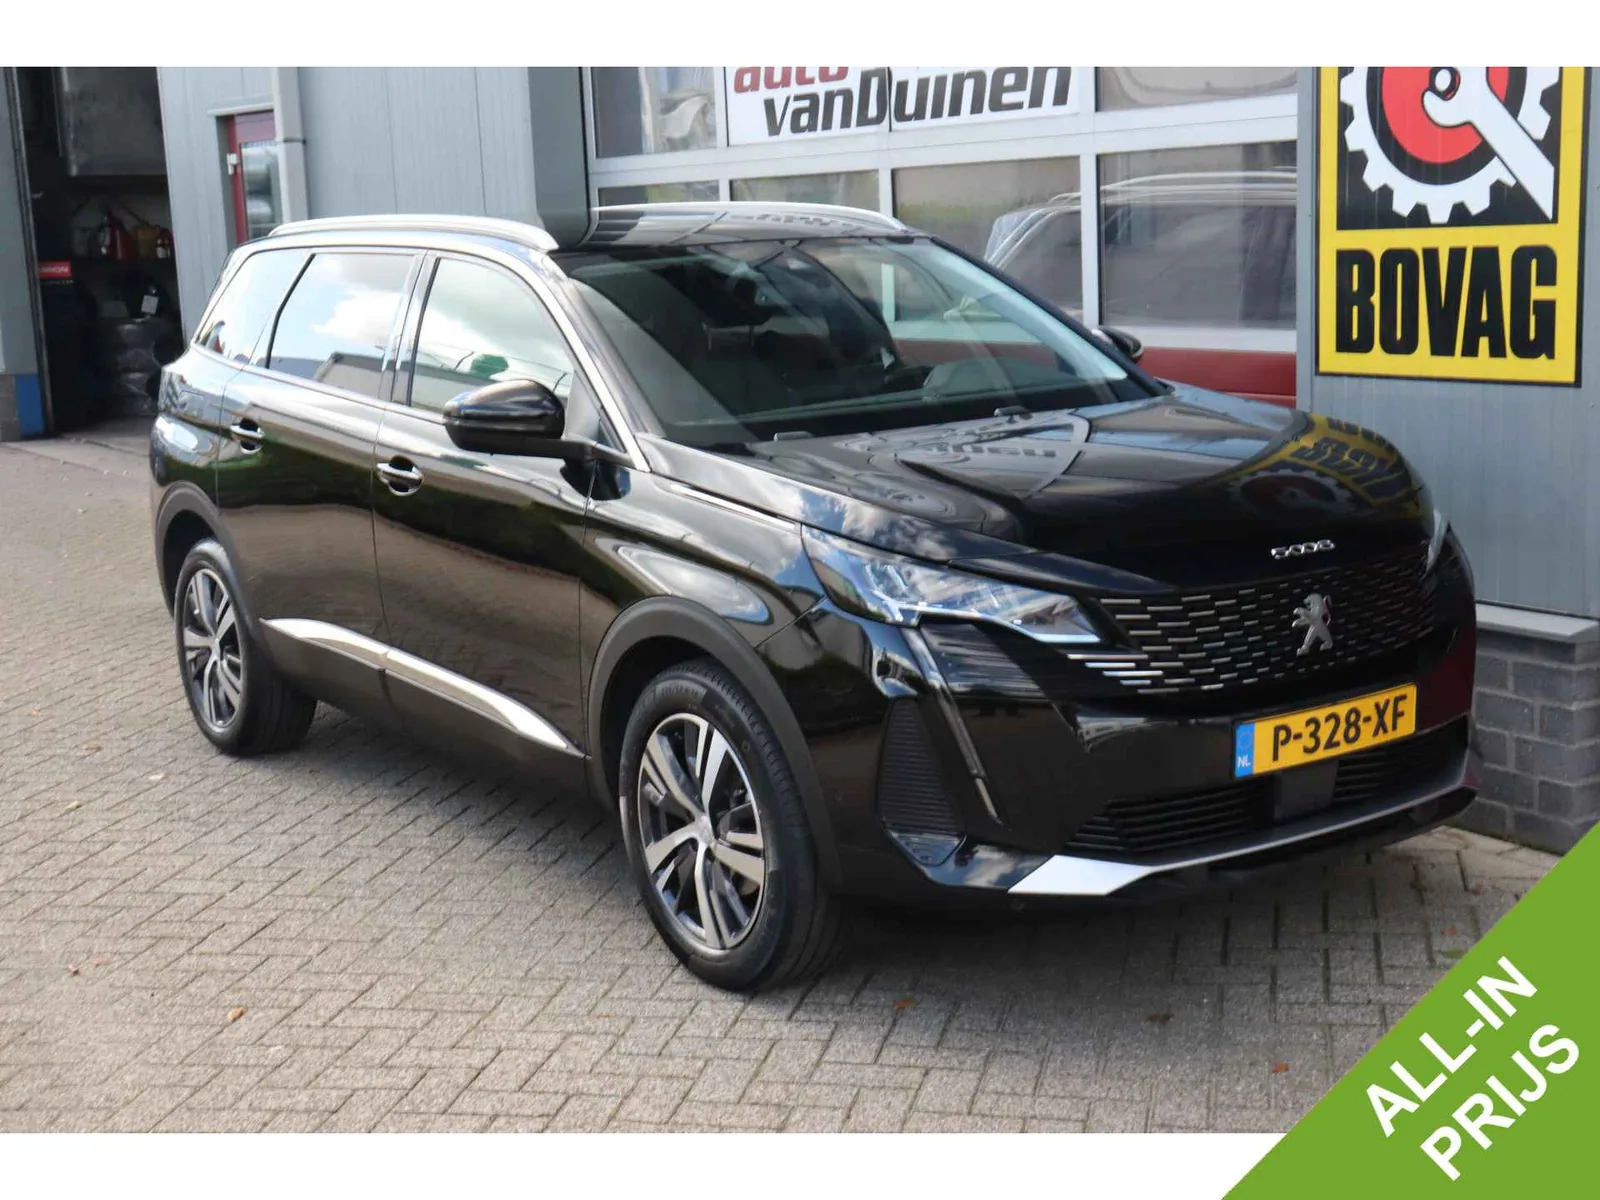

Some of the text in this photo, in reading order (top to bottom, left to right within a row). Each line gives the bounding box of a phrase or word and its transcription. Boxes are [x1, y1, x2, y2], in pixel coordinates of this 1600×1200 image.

[1335, 244, 1558, 360] BOVAG
[1237, 694, 1408, 768] NL P-328-XF
